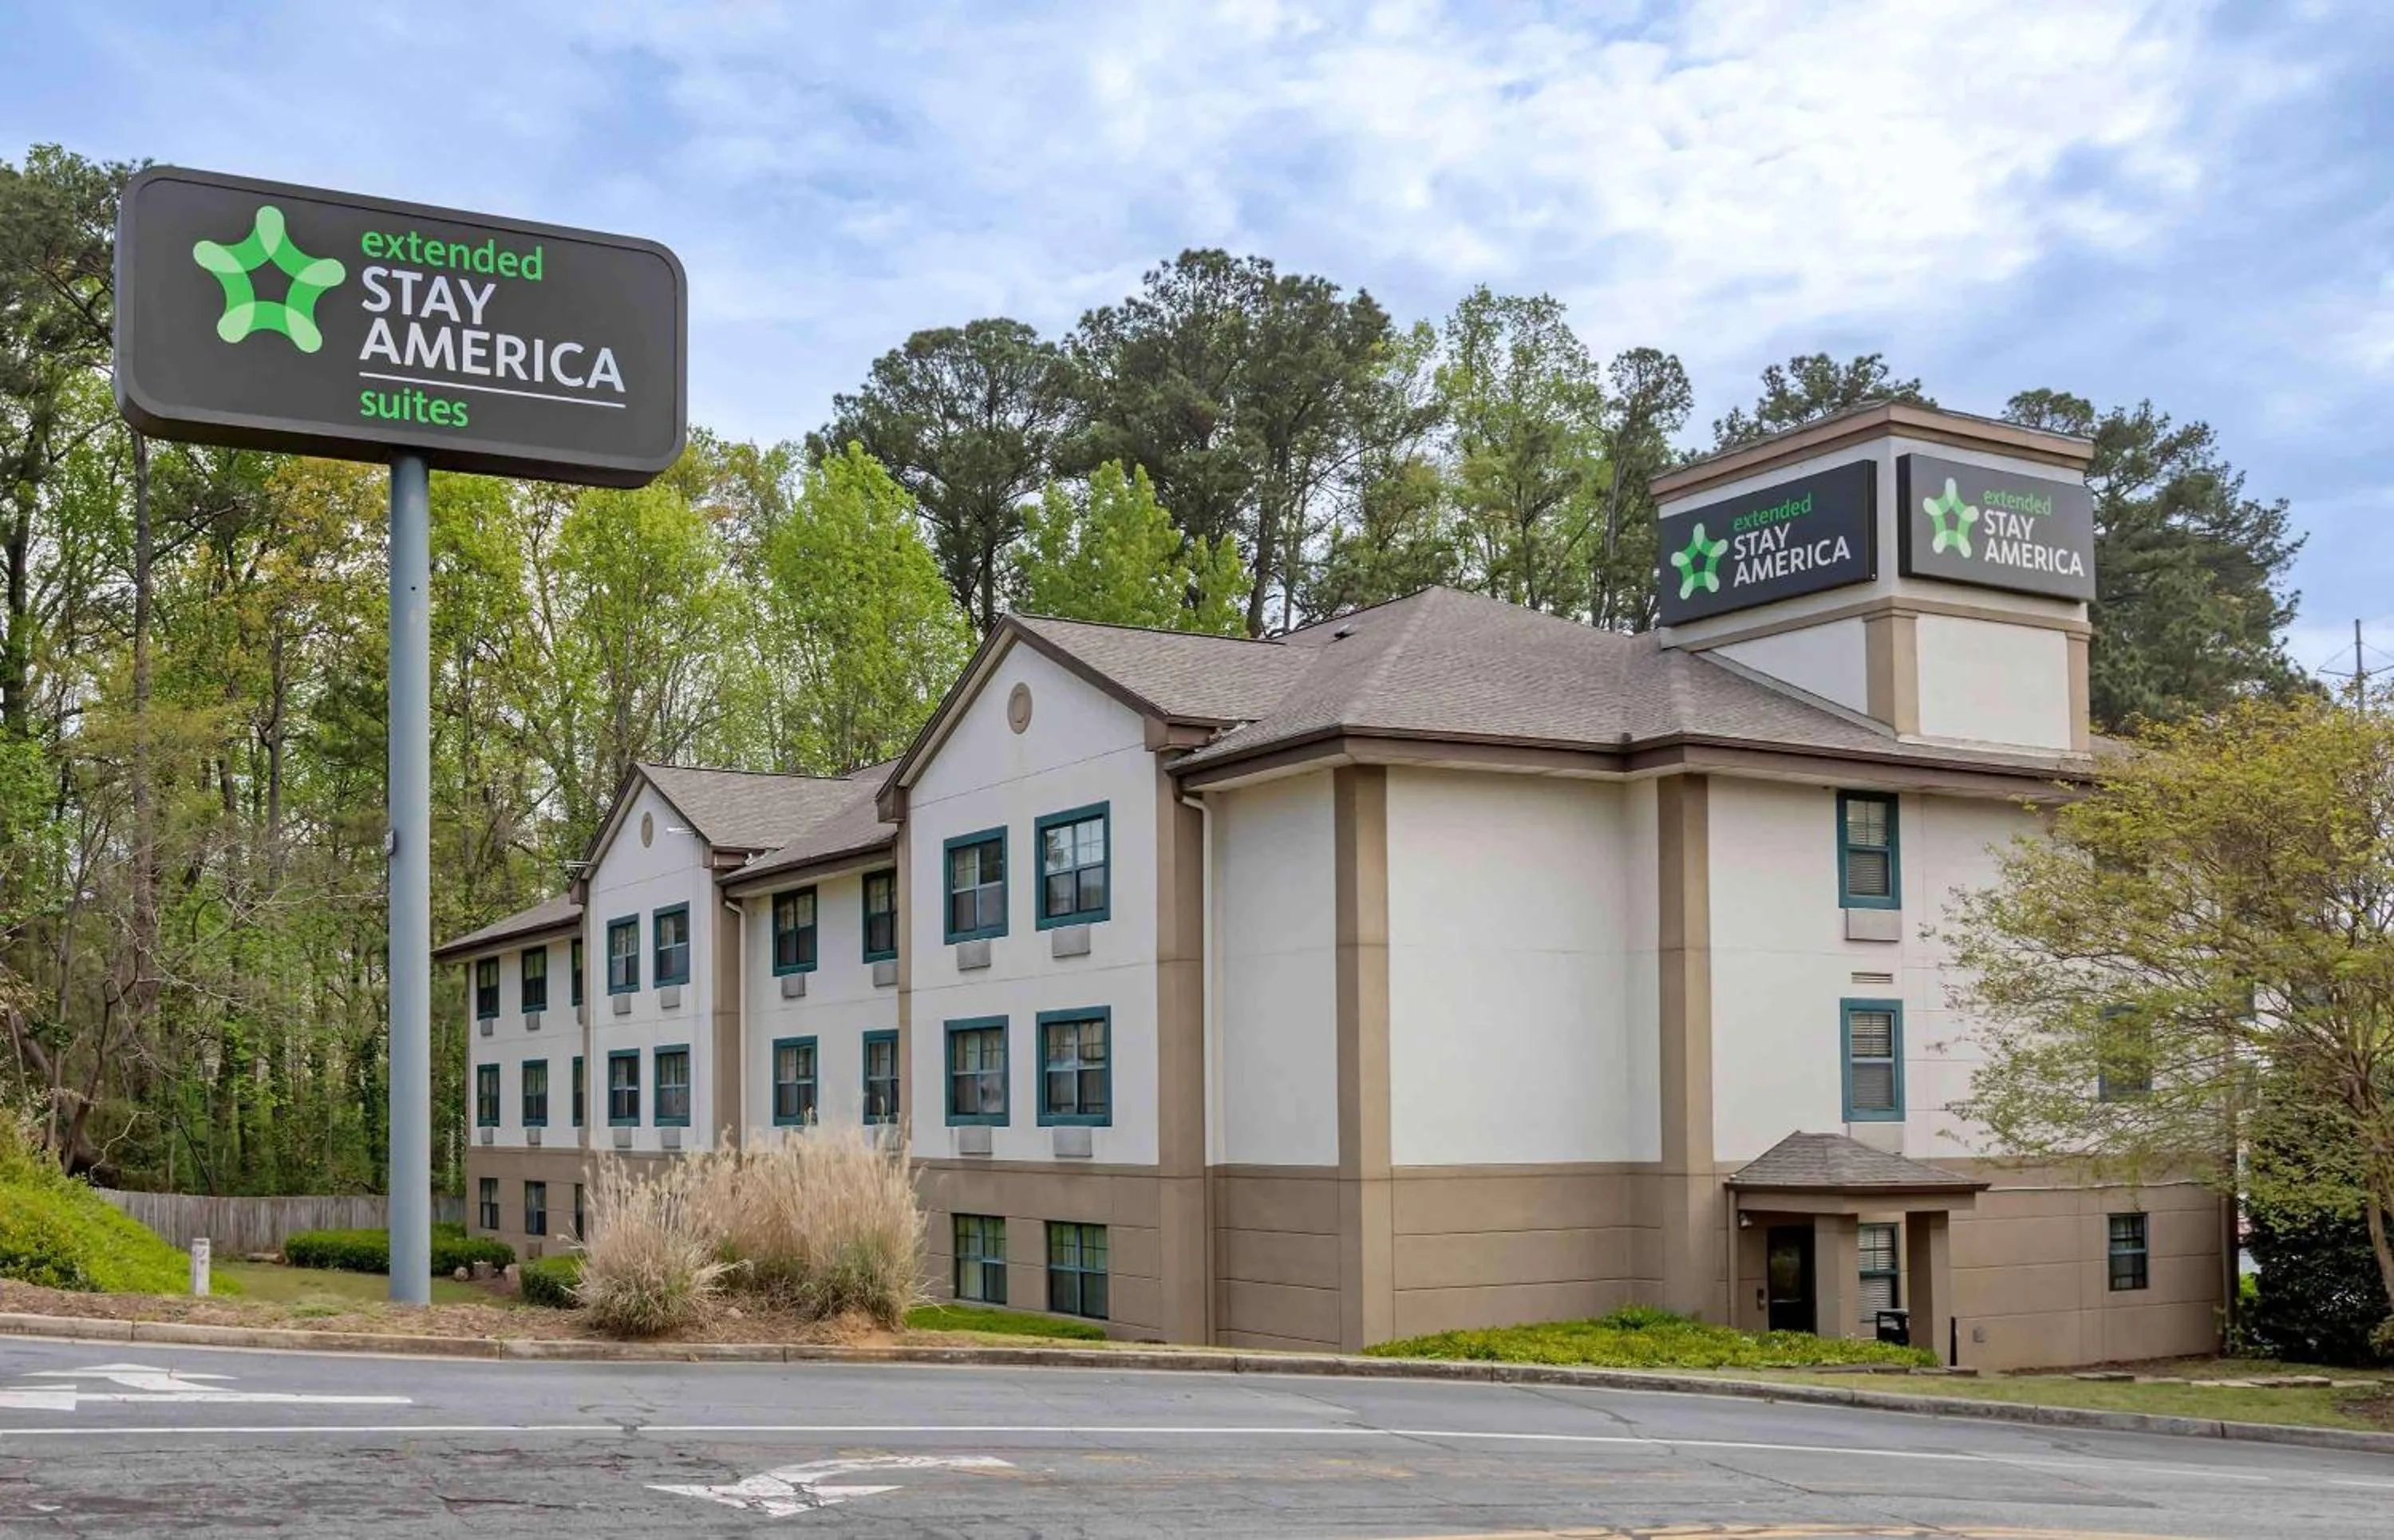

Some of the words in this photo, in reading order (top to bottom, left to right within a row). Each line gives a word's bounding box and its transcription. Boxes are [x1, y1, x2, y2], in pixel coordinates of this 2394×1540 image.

[361, 229, 543, 281] extended
[361, 267, 496, 325] STAY
[359, 318, 626, 393] AMERICA
[361, 388, 468, 428] suites
[1733, 492, 1811, 531] extended
[1984, 490, 2052, 515] extended
[1733, 523, 1791, 560] STAY
[1984, 509, 2035, 541] STAY
[1733, 535, 1851, 587] AMERICA
[1984, 538, 2085, 578] AMERICA
